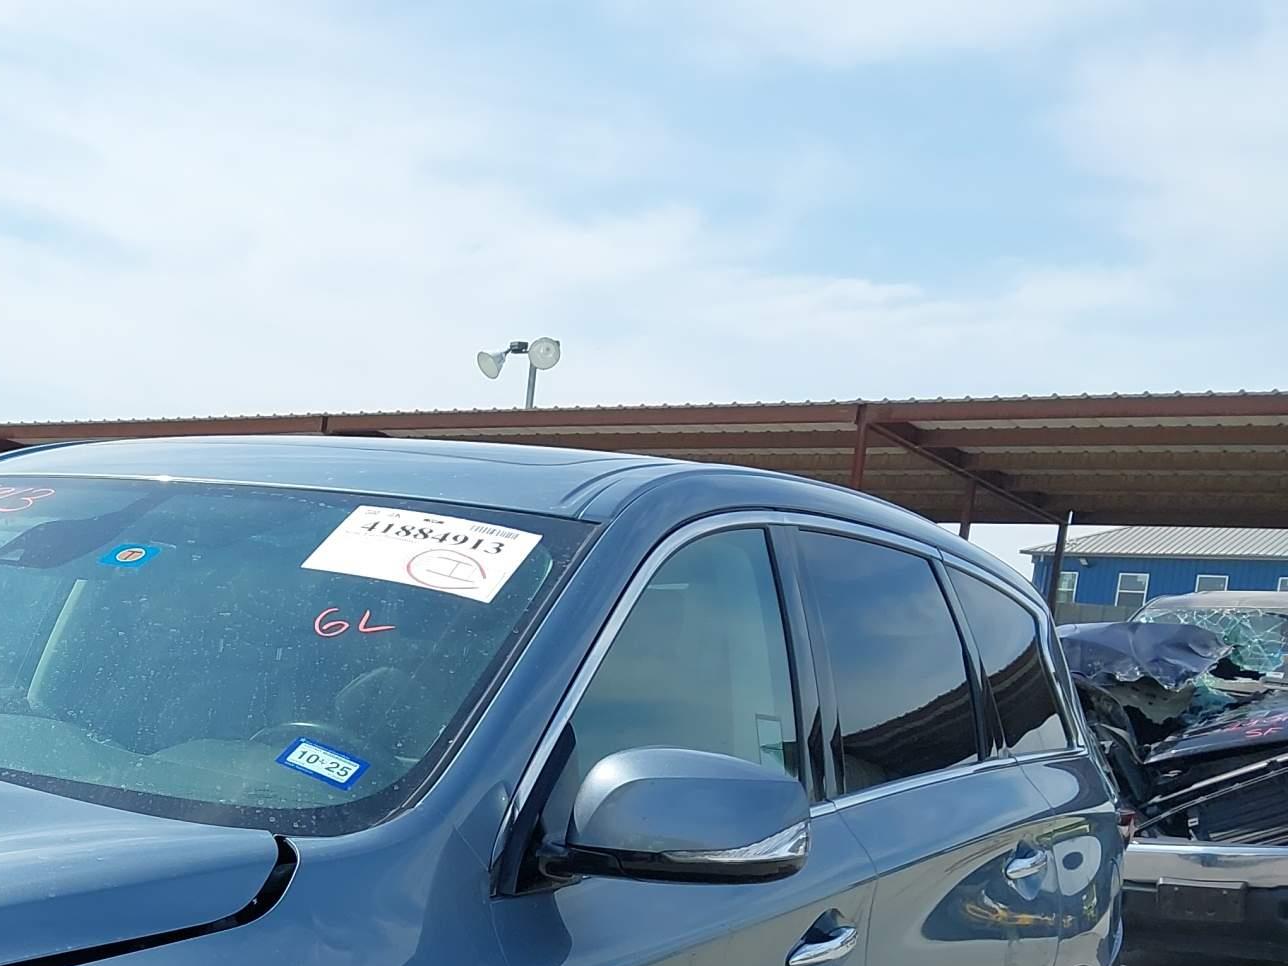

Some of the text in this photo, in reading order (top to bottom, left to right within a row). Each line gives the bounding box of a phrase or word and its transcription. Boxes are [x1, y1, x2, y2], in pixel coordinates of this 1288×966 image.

[360, 520, 505, 555] 41884913
[297, 750, 320, 764] 10
[324, 761, 353, 777] 25
